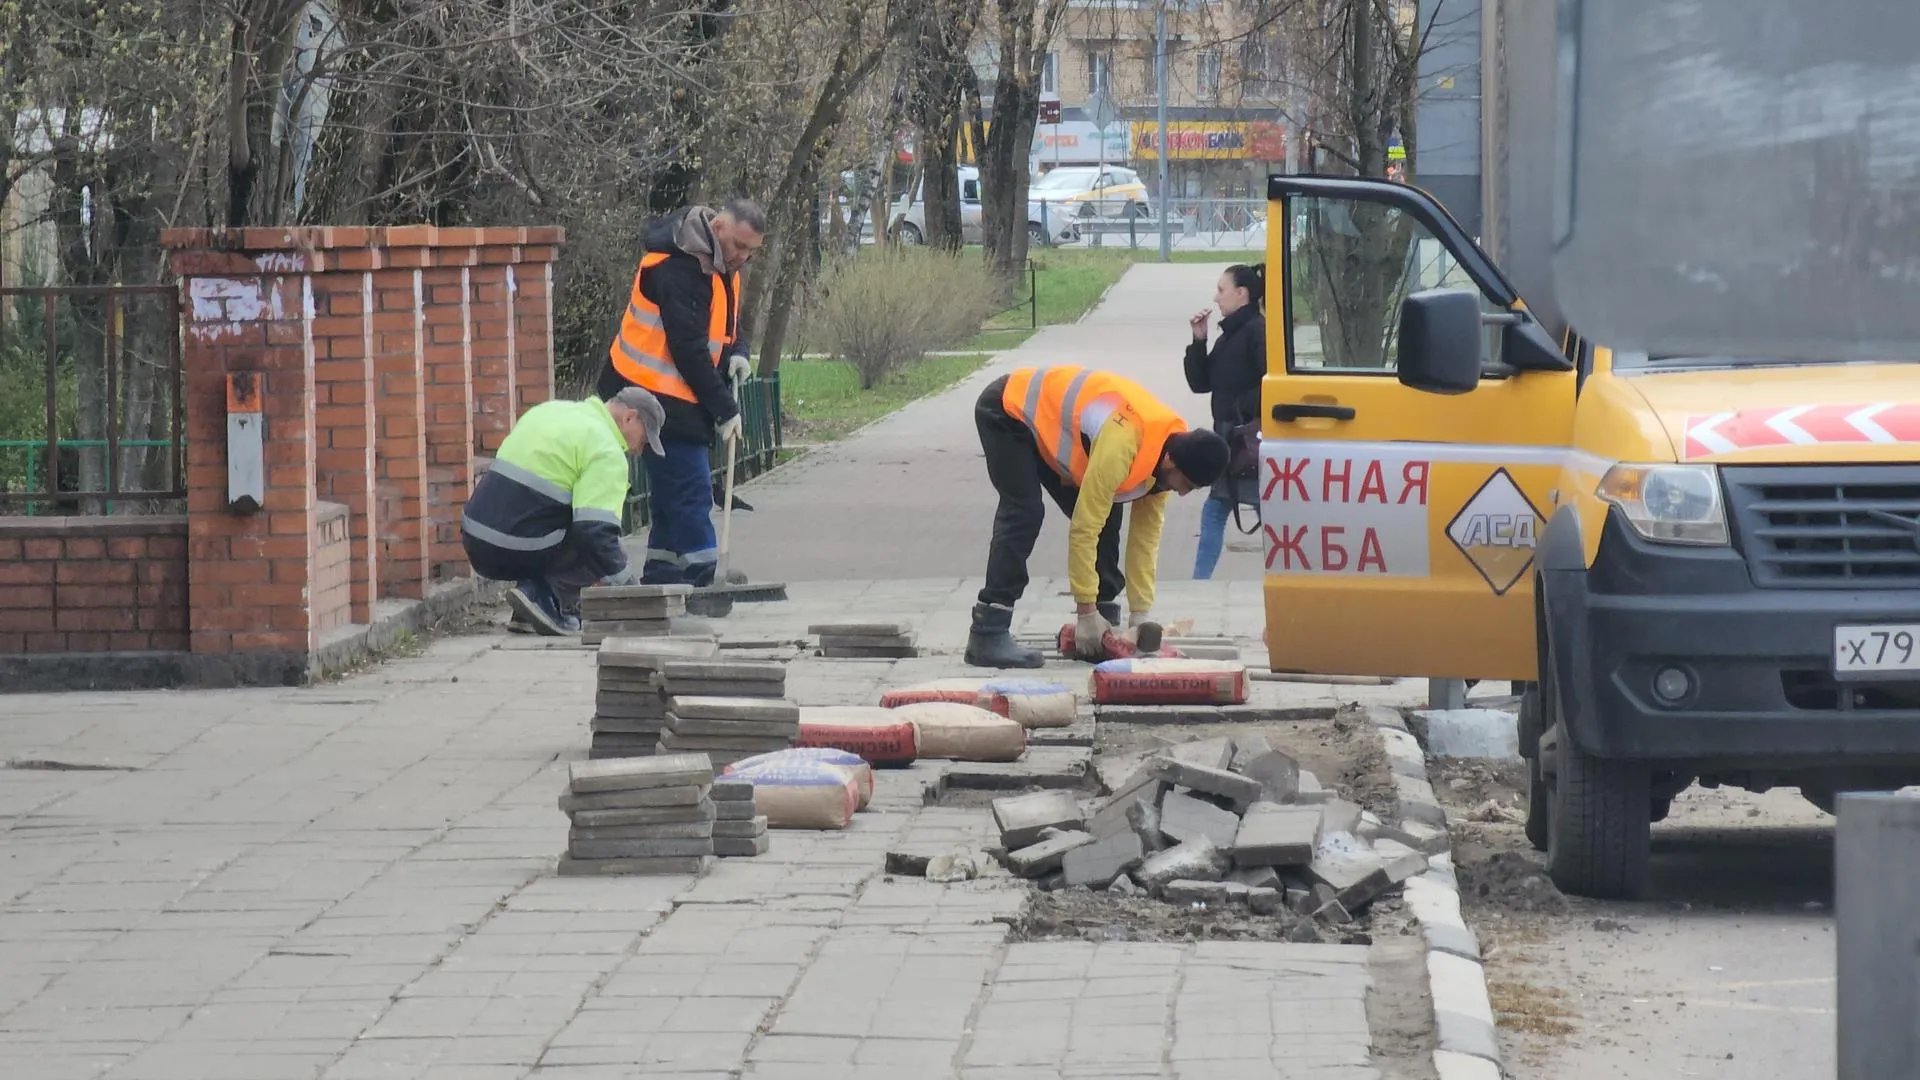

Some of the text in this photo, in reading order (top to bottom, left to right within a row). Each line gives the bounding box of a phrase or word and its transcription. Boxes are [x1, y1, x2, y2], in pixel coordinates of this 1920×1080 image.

[1150, 131, 1244, 149] СВКОМБАНК
[1262, 457, 1430, 504] ЖНАЯ
[1264, 524, 1388, 572] ЖБА
[1462, 513, 1537, 548] АСД
[1848, 631, 1919, 664] Х79
